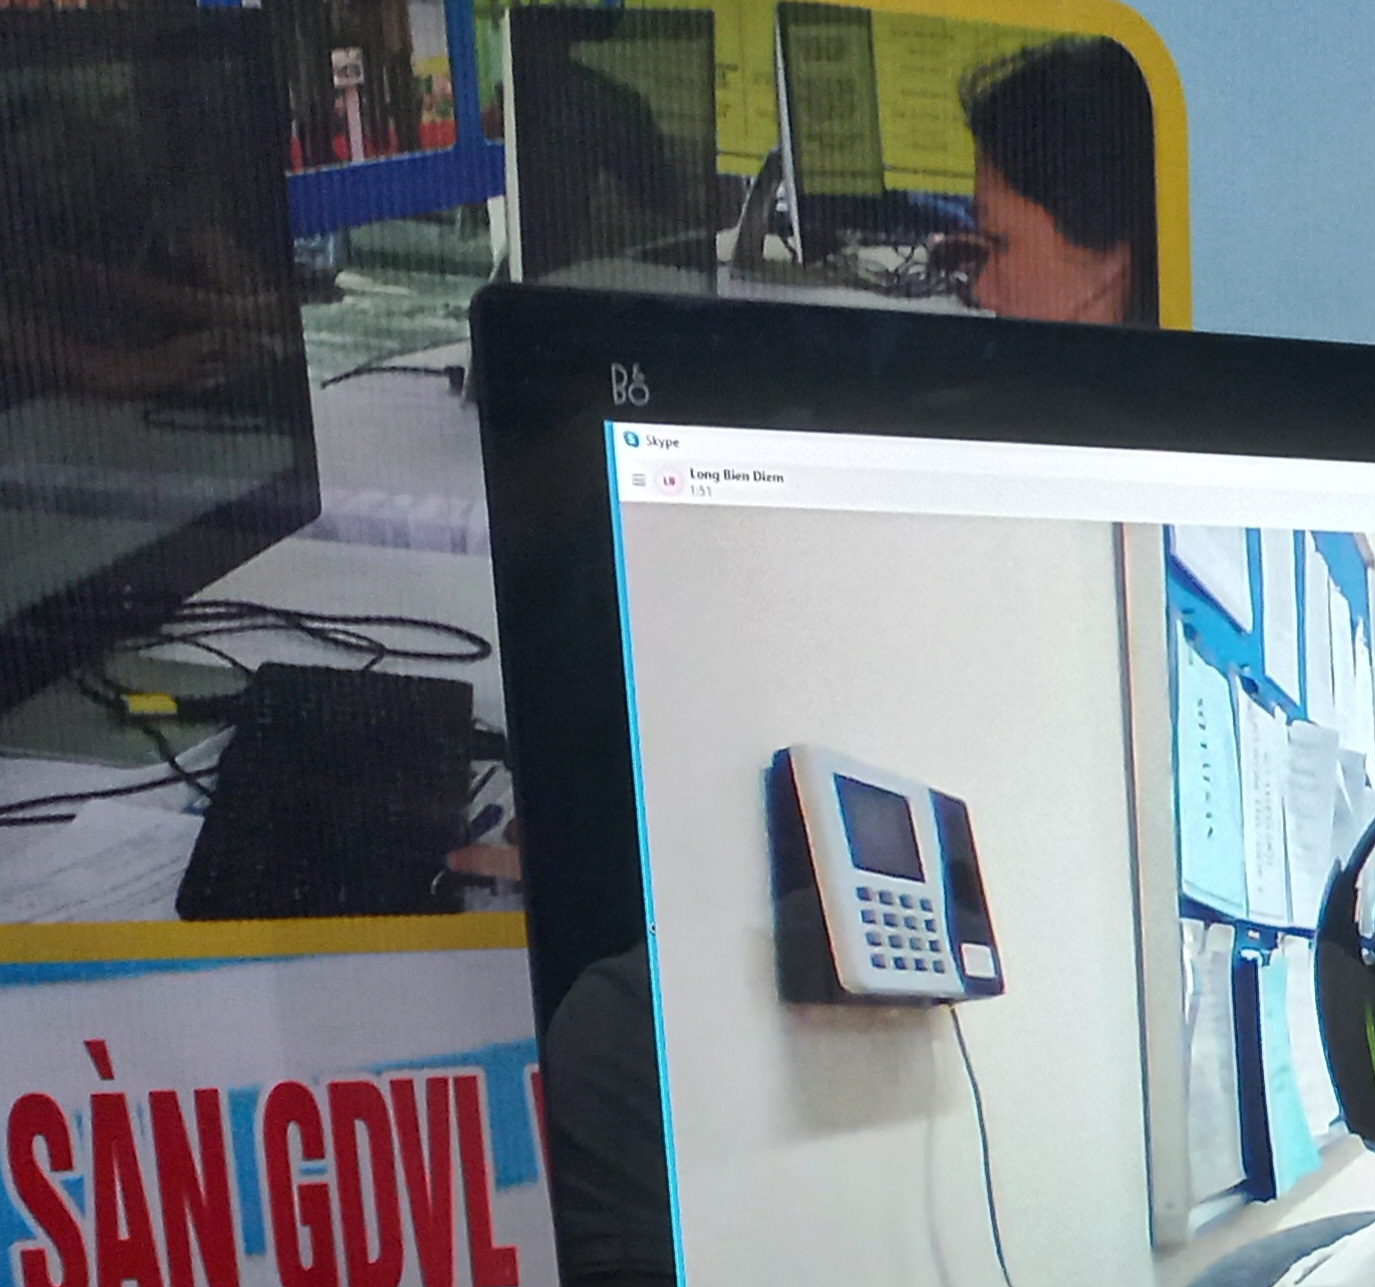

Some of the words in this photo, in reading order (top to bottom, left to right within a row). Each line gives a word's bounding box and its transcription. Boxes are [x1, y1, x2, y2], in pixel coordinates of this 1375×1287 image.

[646, 434, 680, 450] Skype
[690, 467, 720, 482] Long
[723, 469, 750, 482] Bien
[752, 470, 784, 483] Diem
